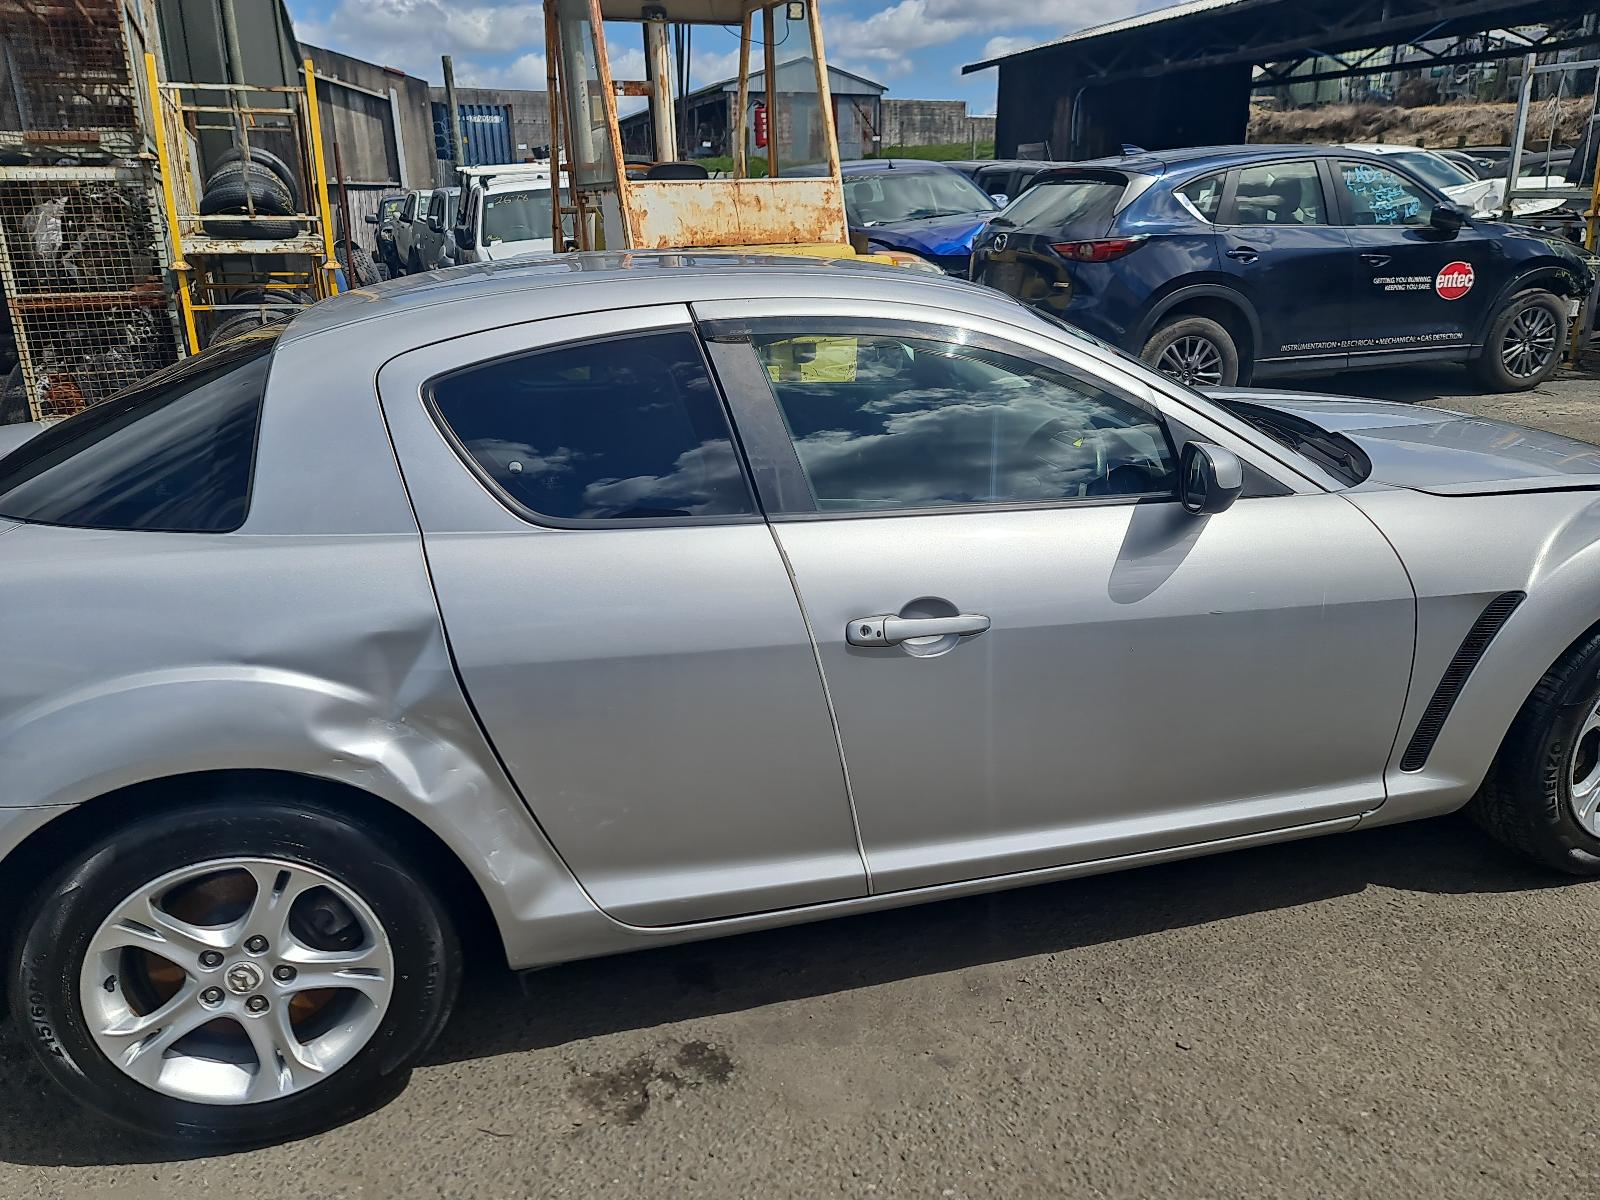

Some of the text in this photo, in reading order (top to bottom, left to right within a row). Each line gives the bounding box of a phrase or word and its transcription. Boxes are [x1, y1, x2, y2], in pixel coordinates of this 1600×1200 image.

[1436, 271, 1474, 288] entec
[1280, 341, 1336, 352] INSTRUMENTATION
[1341, 339, 1374, 348] ELECTRICAL
[1379, 336, 1416, 345] MECHANICAL
[1432, 332, 1463, 341] DETECTION
